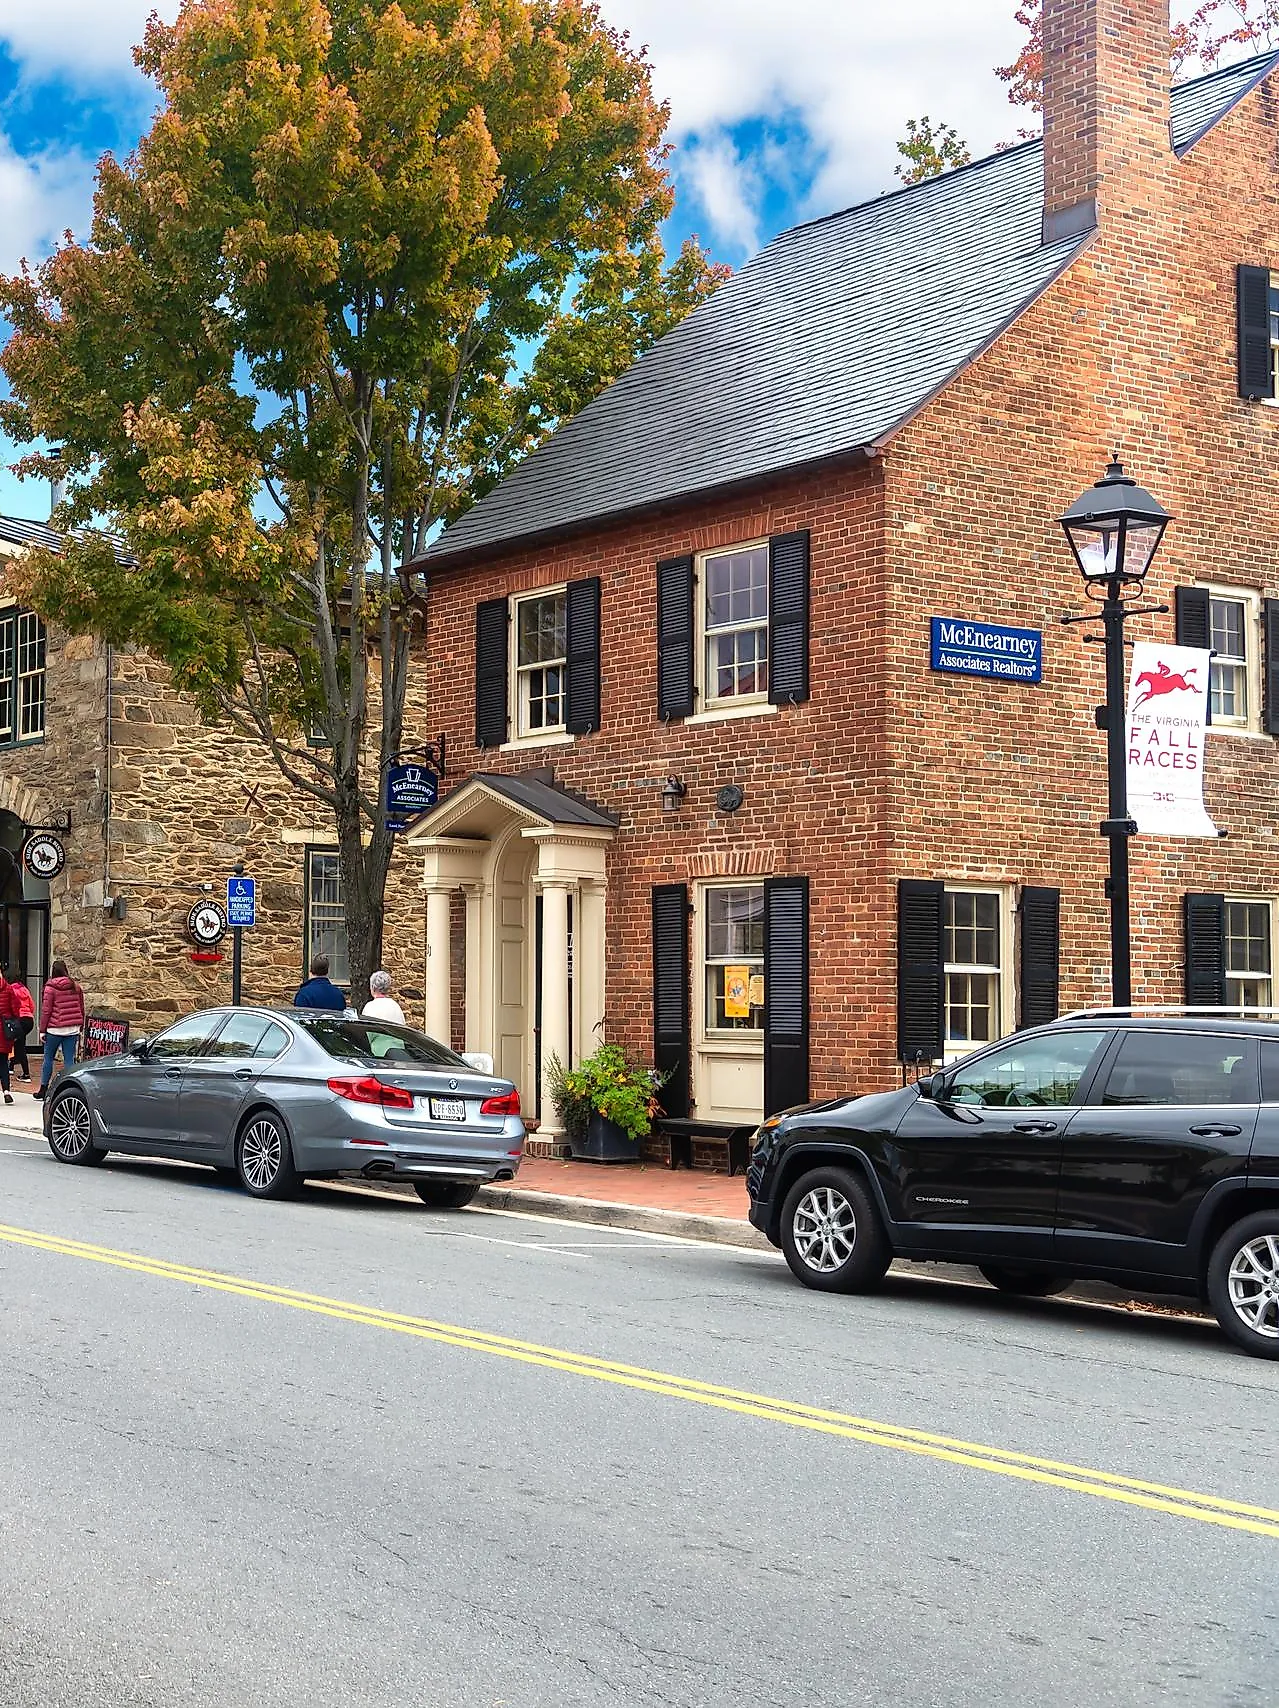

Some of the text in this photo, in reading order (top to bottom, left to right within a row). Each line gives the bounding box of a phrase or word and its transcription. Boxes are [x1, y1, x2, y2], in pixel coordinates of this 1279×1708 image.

[940, 623, 1038, 658] McEnearney
[939, 653, 991, 671] Associates
[1131, 714, 1200, 728] THE VIRGINIA
[1130, 727, 1198, 749] FALL
[1128, 749, 1198, 770] RACES
[392, 782, 434, 796] McEnearney
[397, 795, 429, 803] ASSOCIATES
[26, 836, 64, 862] SIDE SADDLE BISTRO
